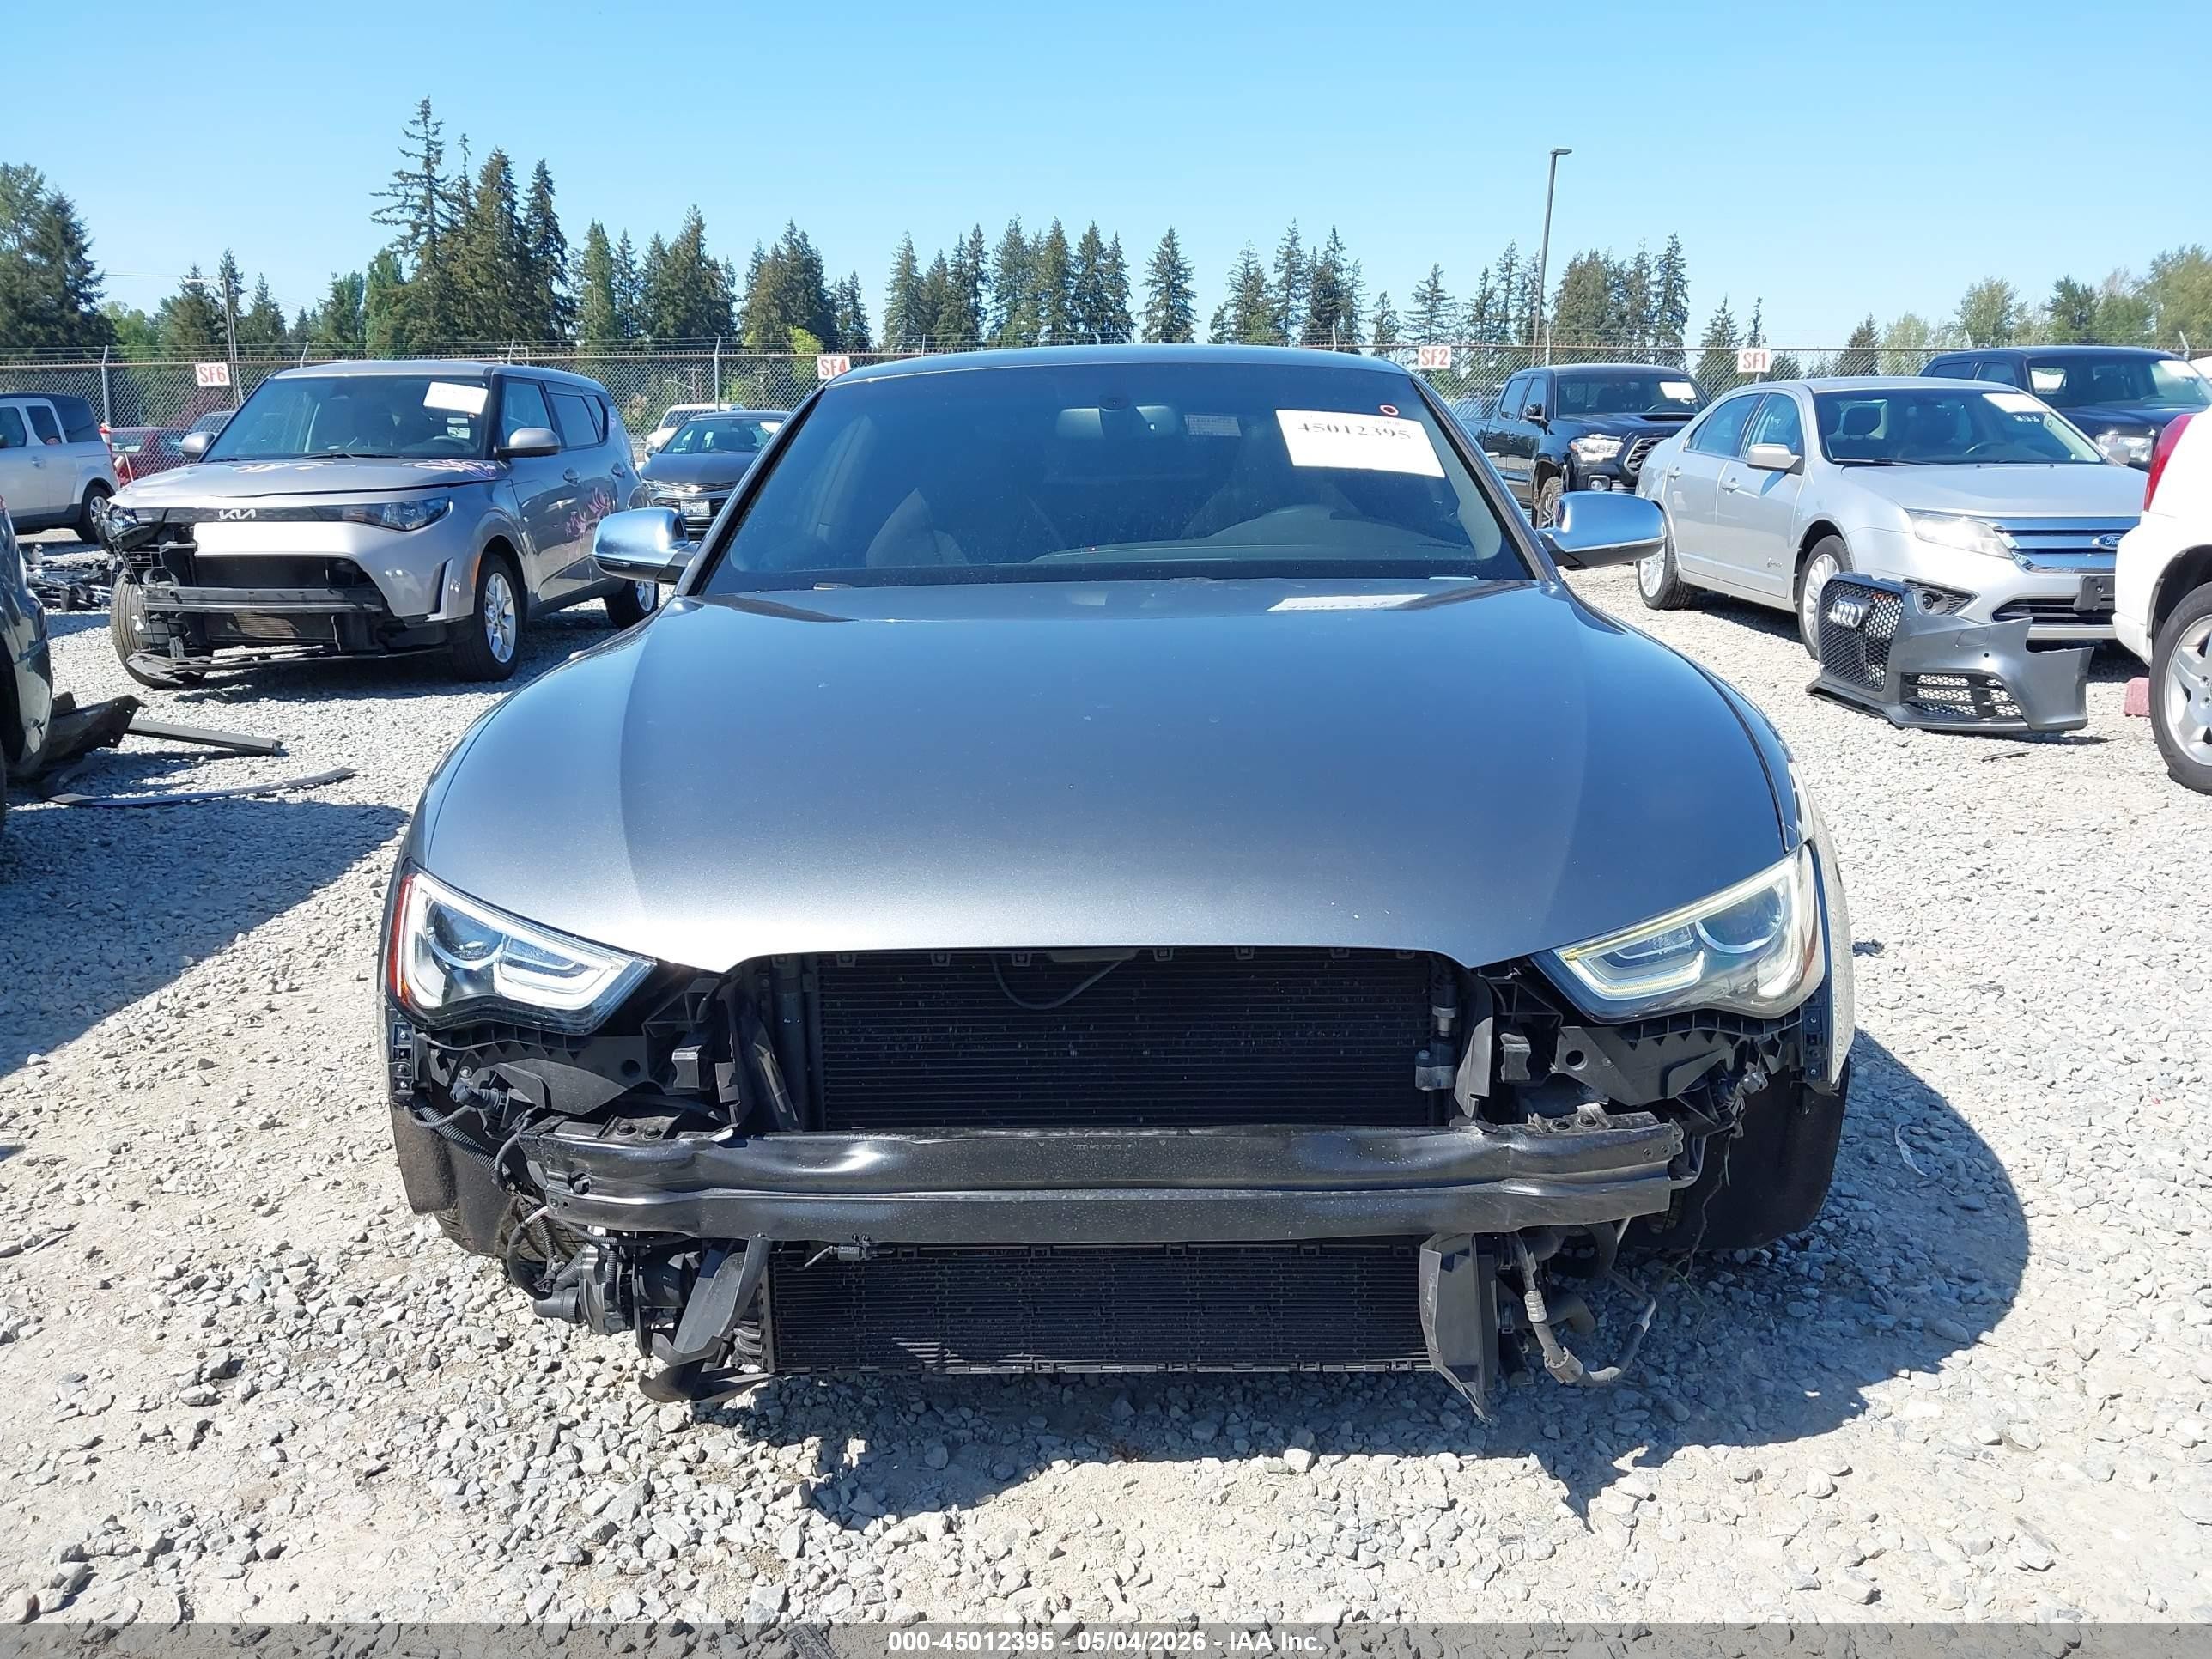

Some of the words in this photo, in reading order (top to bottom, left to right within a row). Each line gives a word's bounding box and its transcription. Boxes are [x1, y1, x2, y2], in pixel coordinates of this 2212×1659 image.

[1421, 349, 1448, 366] SF2
[1743, 352, 1766, 369] SF1
[198, 366, 226, 383] SF6
[1298, 422, 1412, 440] 45012395
